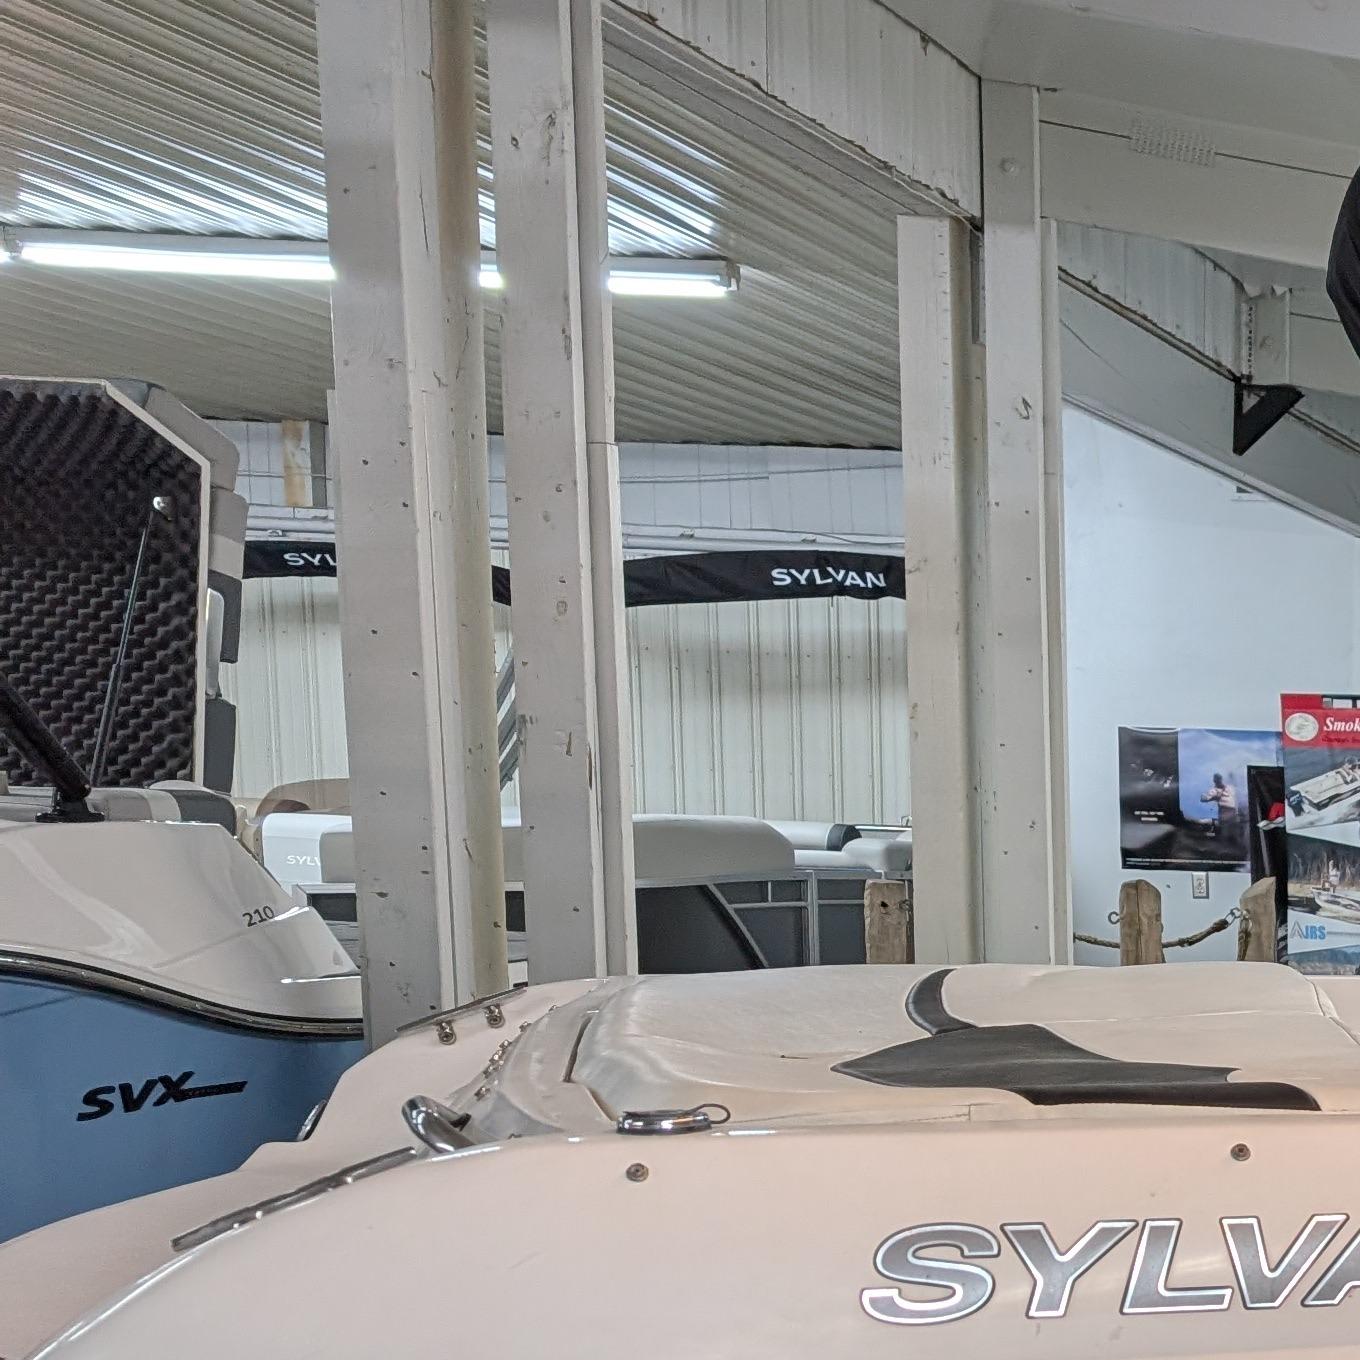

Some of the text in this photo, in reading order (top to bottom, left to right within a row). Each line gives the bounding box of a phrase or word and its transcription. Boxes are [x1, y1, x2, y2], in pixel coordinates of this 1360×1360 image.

[770, 566, 887, 588] SYLVAN
[242, 905, 275, 927] 210
[76, 1070, 248, 1122] SVX
